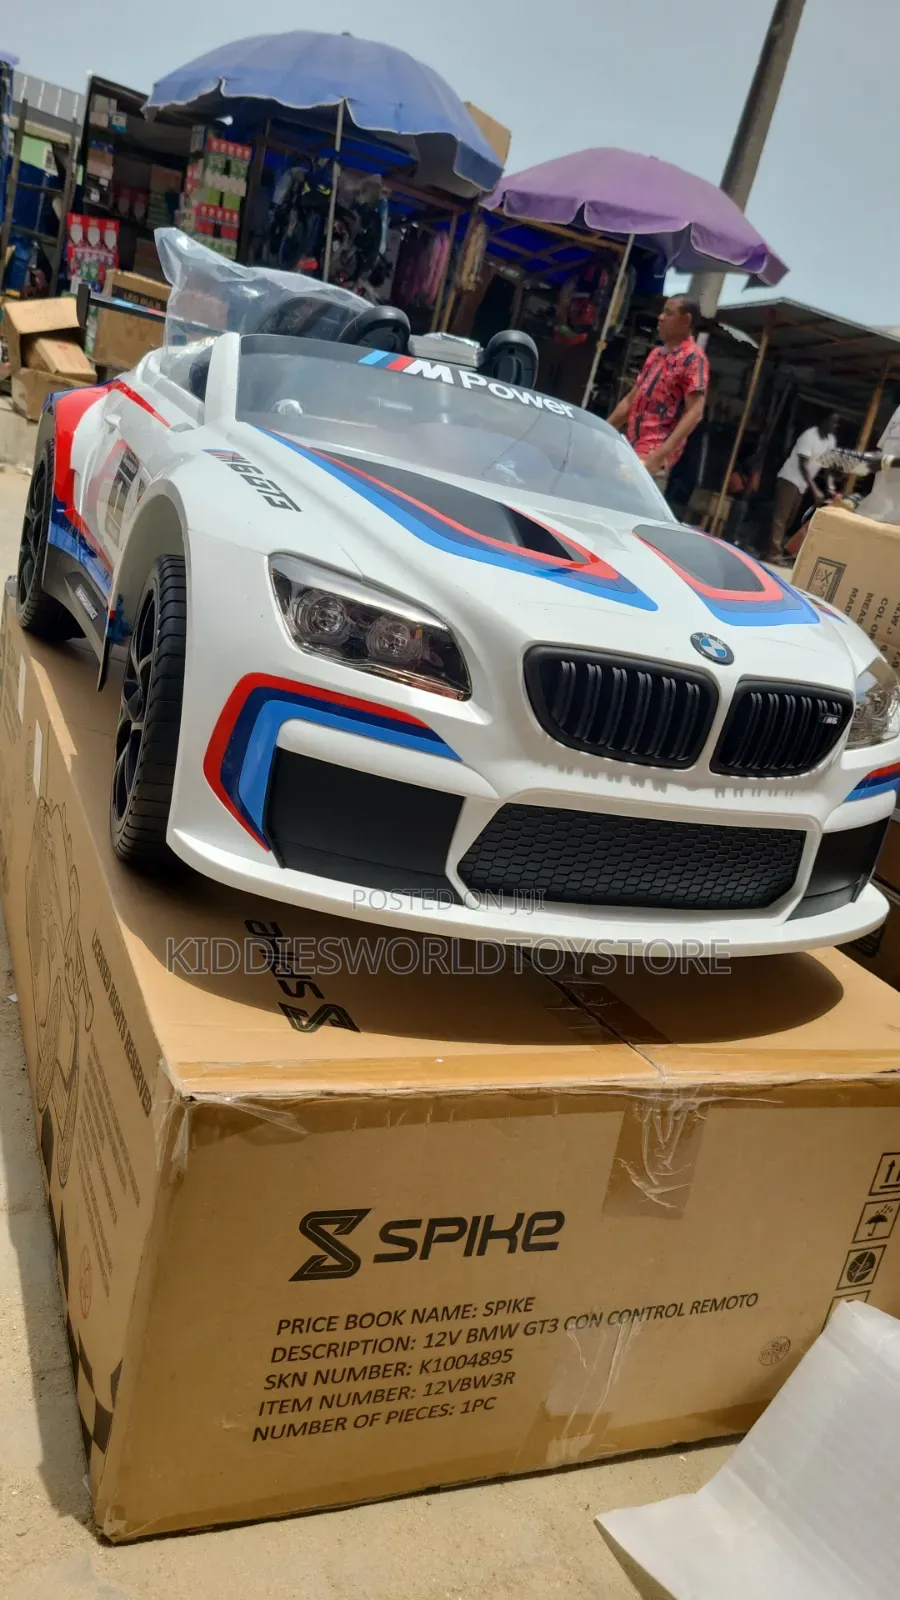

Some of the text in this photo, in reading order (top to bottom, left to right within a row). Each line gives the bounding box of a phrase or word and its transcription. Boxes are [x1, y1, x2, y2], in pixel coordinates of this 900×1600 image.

[124, 1029, 152, 1119] RESERVED
[271, 1292, 759, 1363] DESCRIPTION: 12V BMW GT3 CON CONTROL REMOTO
[276, 1296, 536, 1336] PRICE BOOK NAME: SPIKE
[263, 1348, 514, 1390] SKN NUMBER: K1004895
[258, 1371, 516, 1417] ITEM NUMBER: 12VBW3R
[252, 1396, 497, 1442] NUMBER OF PIECES: 1PC
